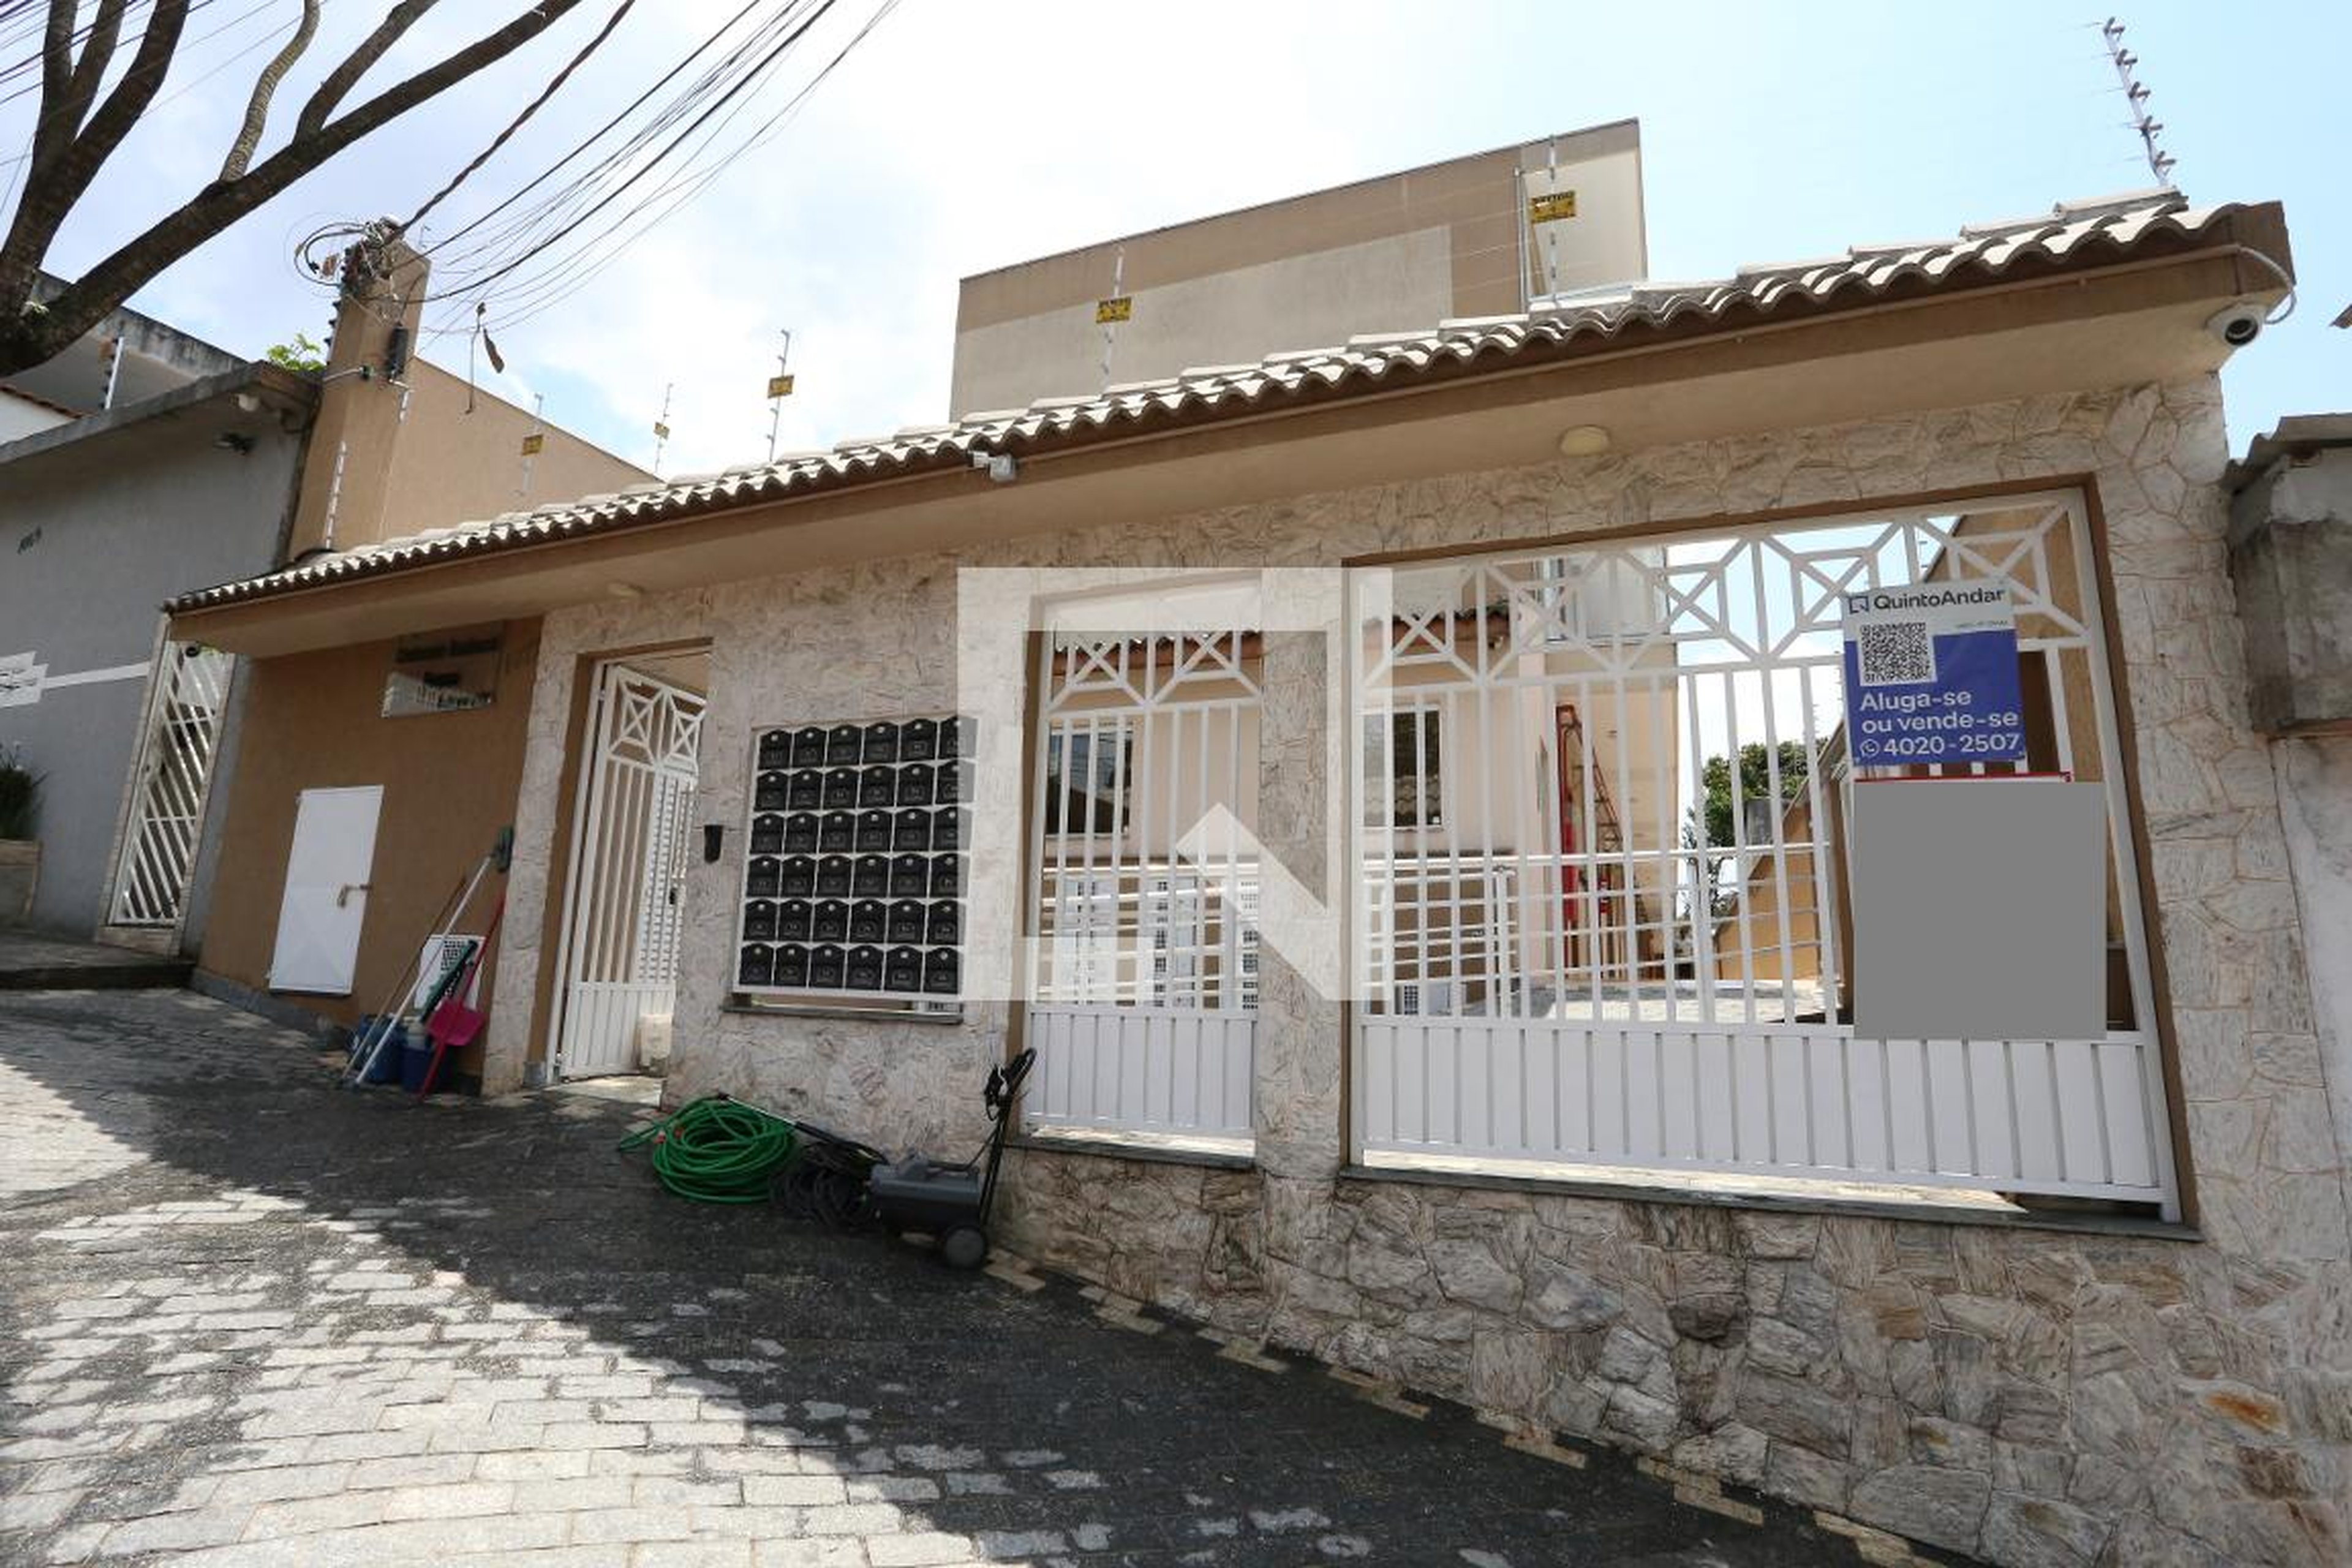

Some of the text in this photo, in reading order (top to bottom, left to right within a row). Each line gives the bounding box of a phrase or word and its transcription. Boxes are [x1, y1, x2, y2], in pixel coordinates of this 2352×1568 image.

[1874, 588, 2005, 611] QuintoAndar
[1860, 691, 1972, 714] Aluga-se
[1861, 712, 2019, 734] ou vende-se
